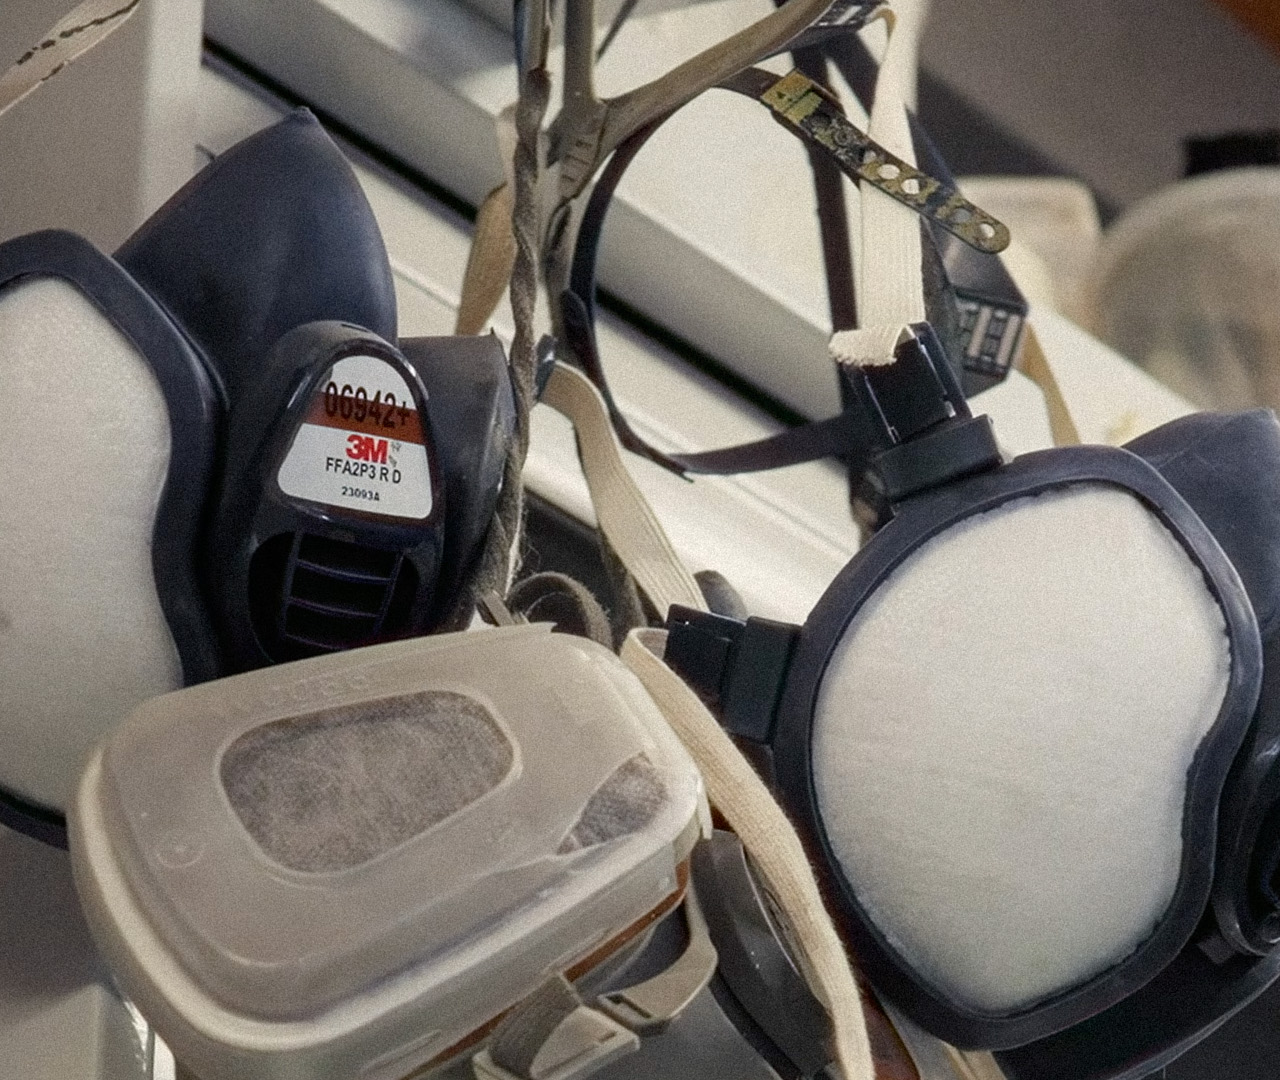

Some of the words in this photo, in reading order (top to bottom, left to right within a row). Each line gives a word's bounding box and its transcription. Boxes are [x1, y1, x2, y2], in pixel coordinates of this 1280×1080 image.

[324, 381, 410, 428] 06942+
[345, 434, 388, 464] 3M
[325, 457, 376, 480] FFA2P3
[379, 465, 389, 482] R
[392, 468, 401, 484] D
